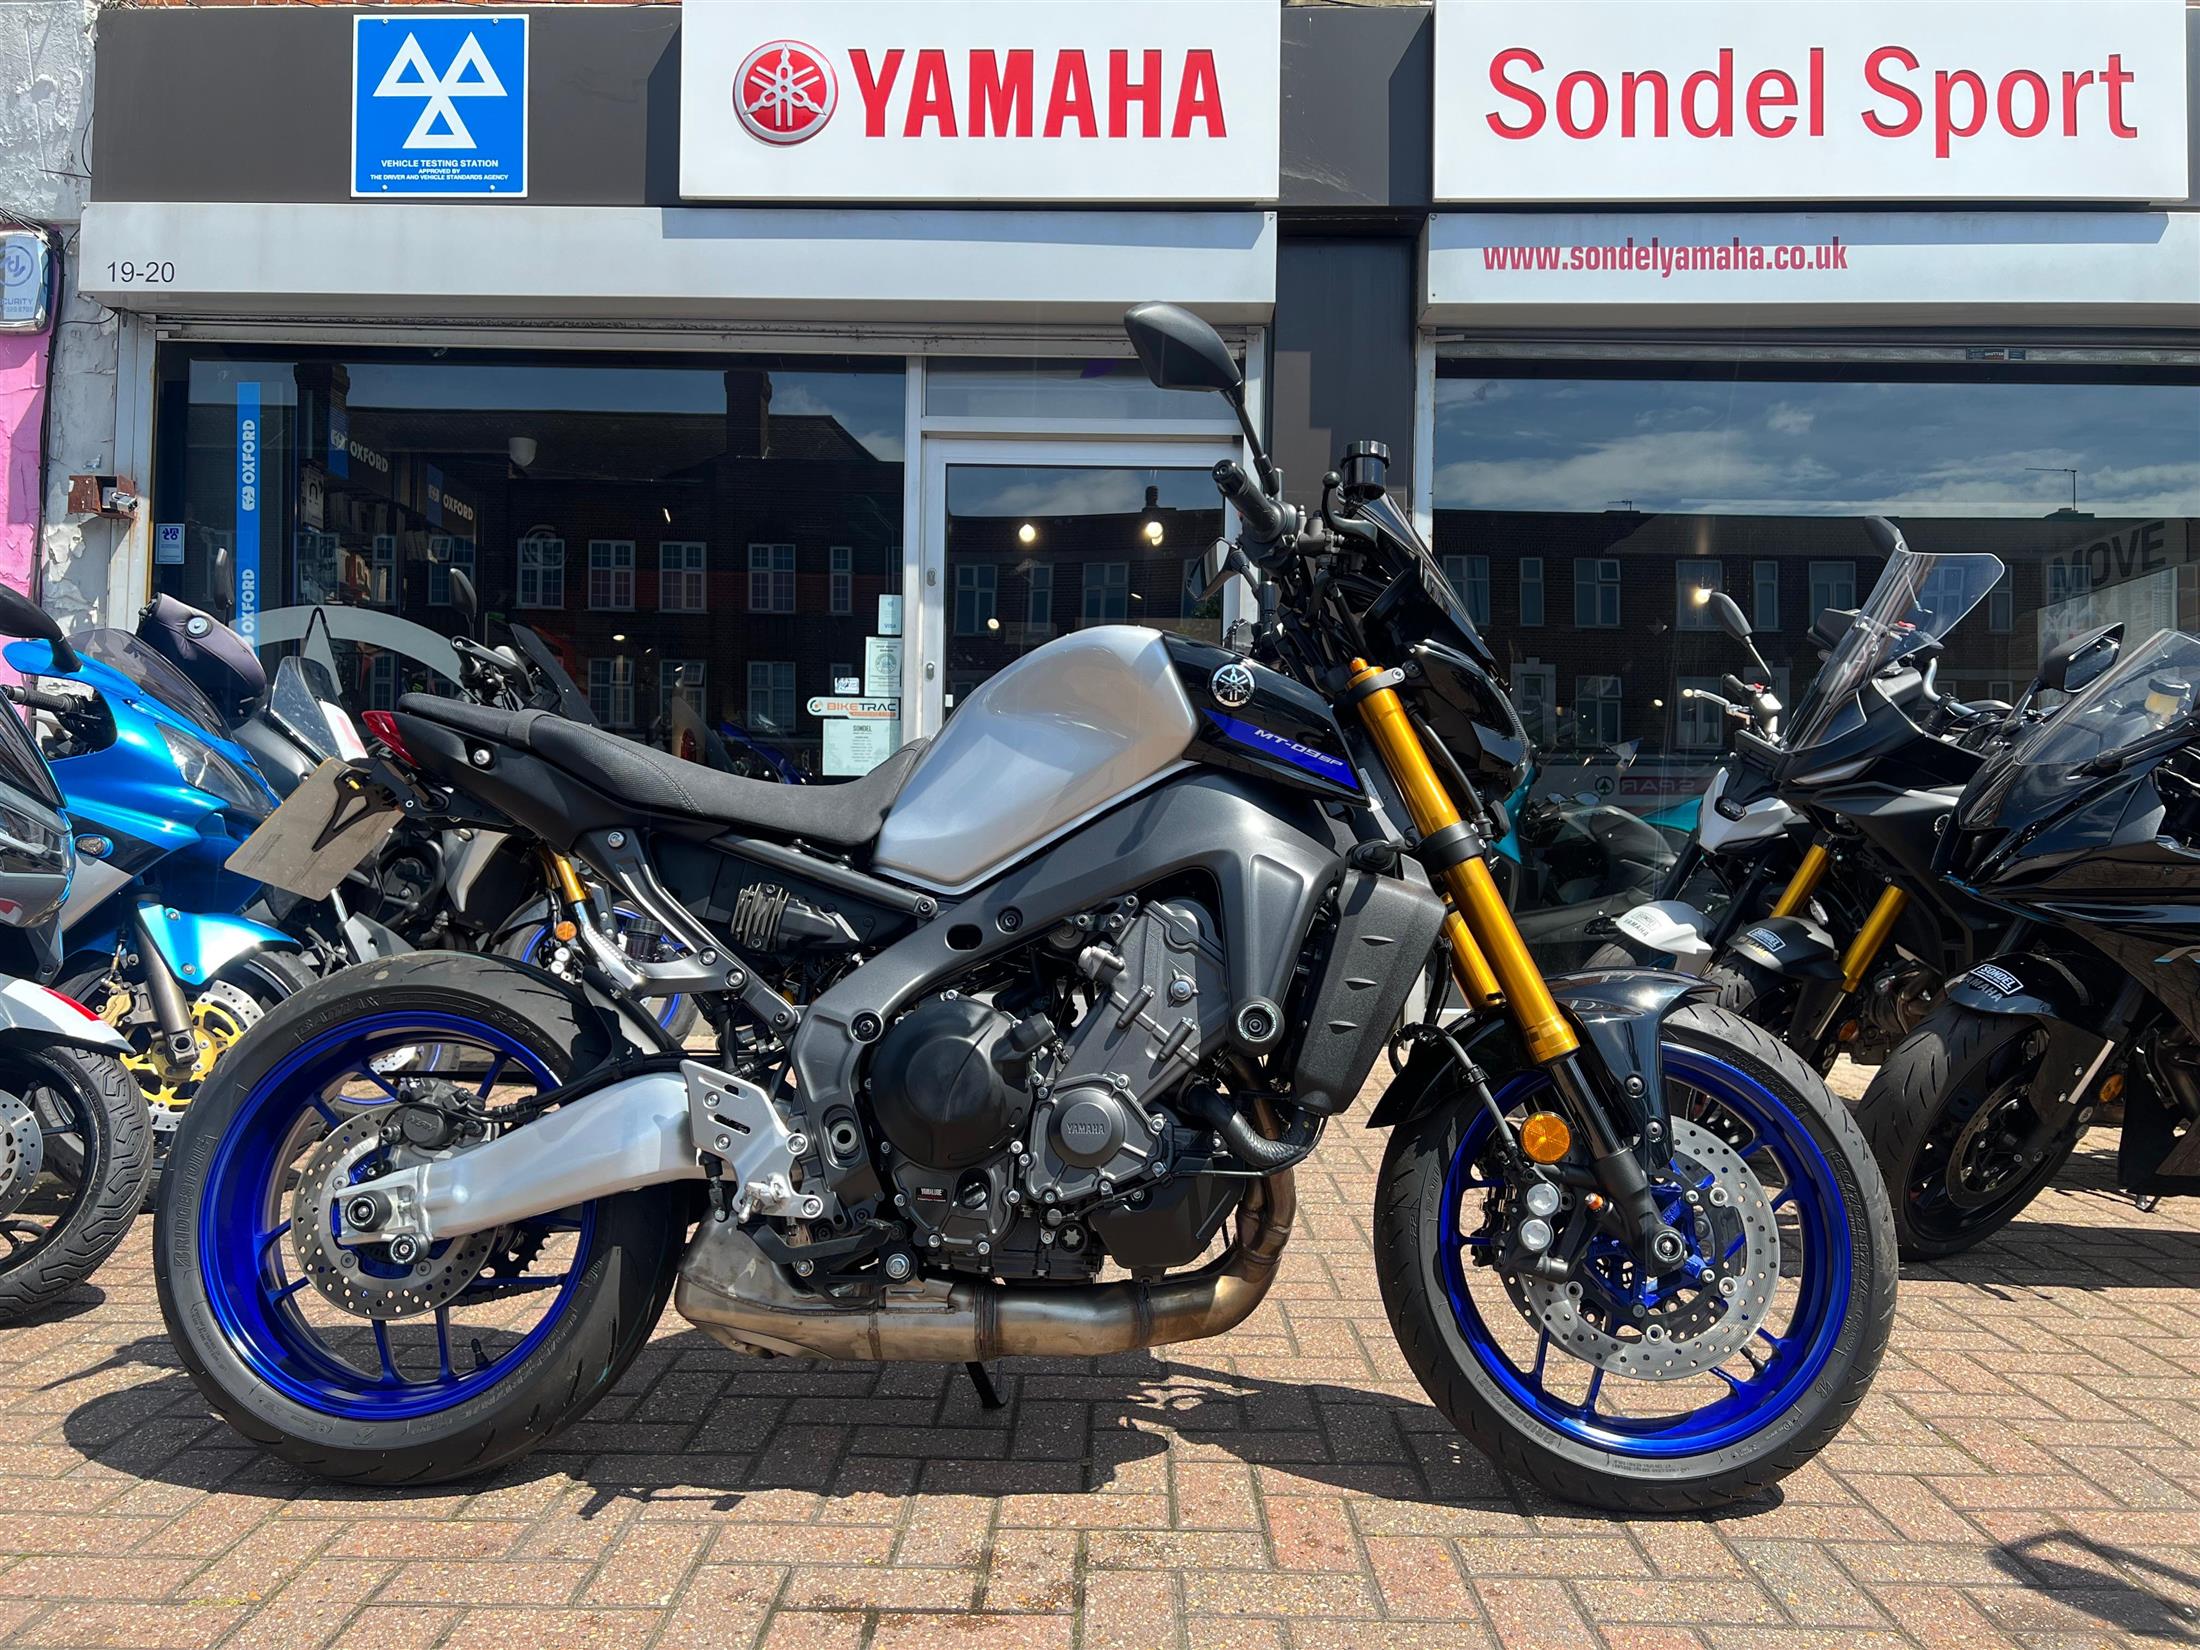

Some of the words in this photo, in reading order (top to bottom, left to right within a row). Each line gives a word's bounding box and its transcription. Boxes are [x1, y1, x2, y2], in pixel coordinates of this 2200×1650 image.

[848, 49, 1227, 138] YAMAHA
[1486, 47, 1824, 139] Sondel
[1861, 46, 2139, 158] Sport
[381, 160, 419, 168] VEHICLE
[421, 160, 458, 168] TESTING
[460, 160, 499, 168] STATION
[107, 261, 175, 283] 19-20
[1483, 236, 1848, 278] www.sondelyamaha.co.uk
[242, 419, 256, 484] OXFORD
[350, 441, 388, 472] OXFORD
[443, 494, 473, 530] OXFORD
[2053, 520, 2166, 600] MOVE
[242, 568, 256, 633] OXFORD
[827, 703, 896, 711] BIKETRAC
[1754, 929, 1780, 948] SONDEL
[1980, 966, 2016, 989] SONDEL
[1066, 1122, 1105, 1135] YAMAHA
[174, 1137, 208, 1267] BRIDGESTONE
